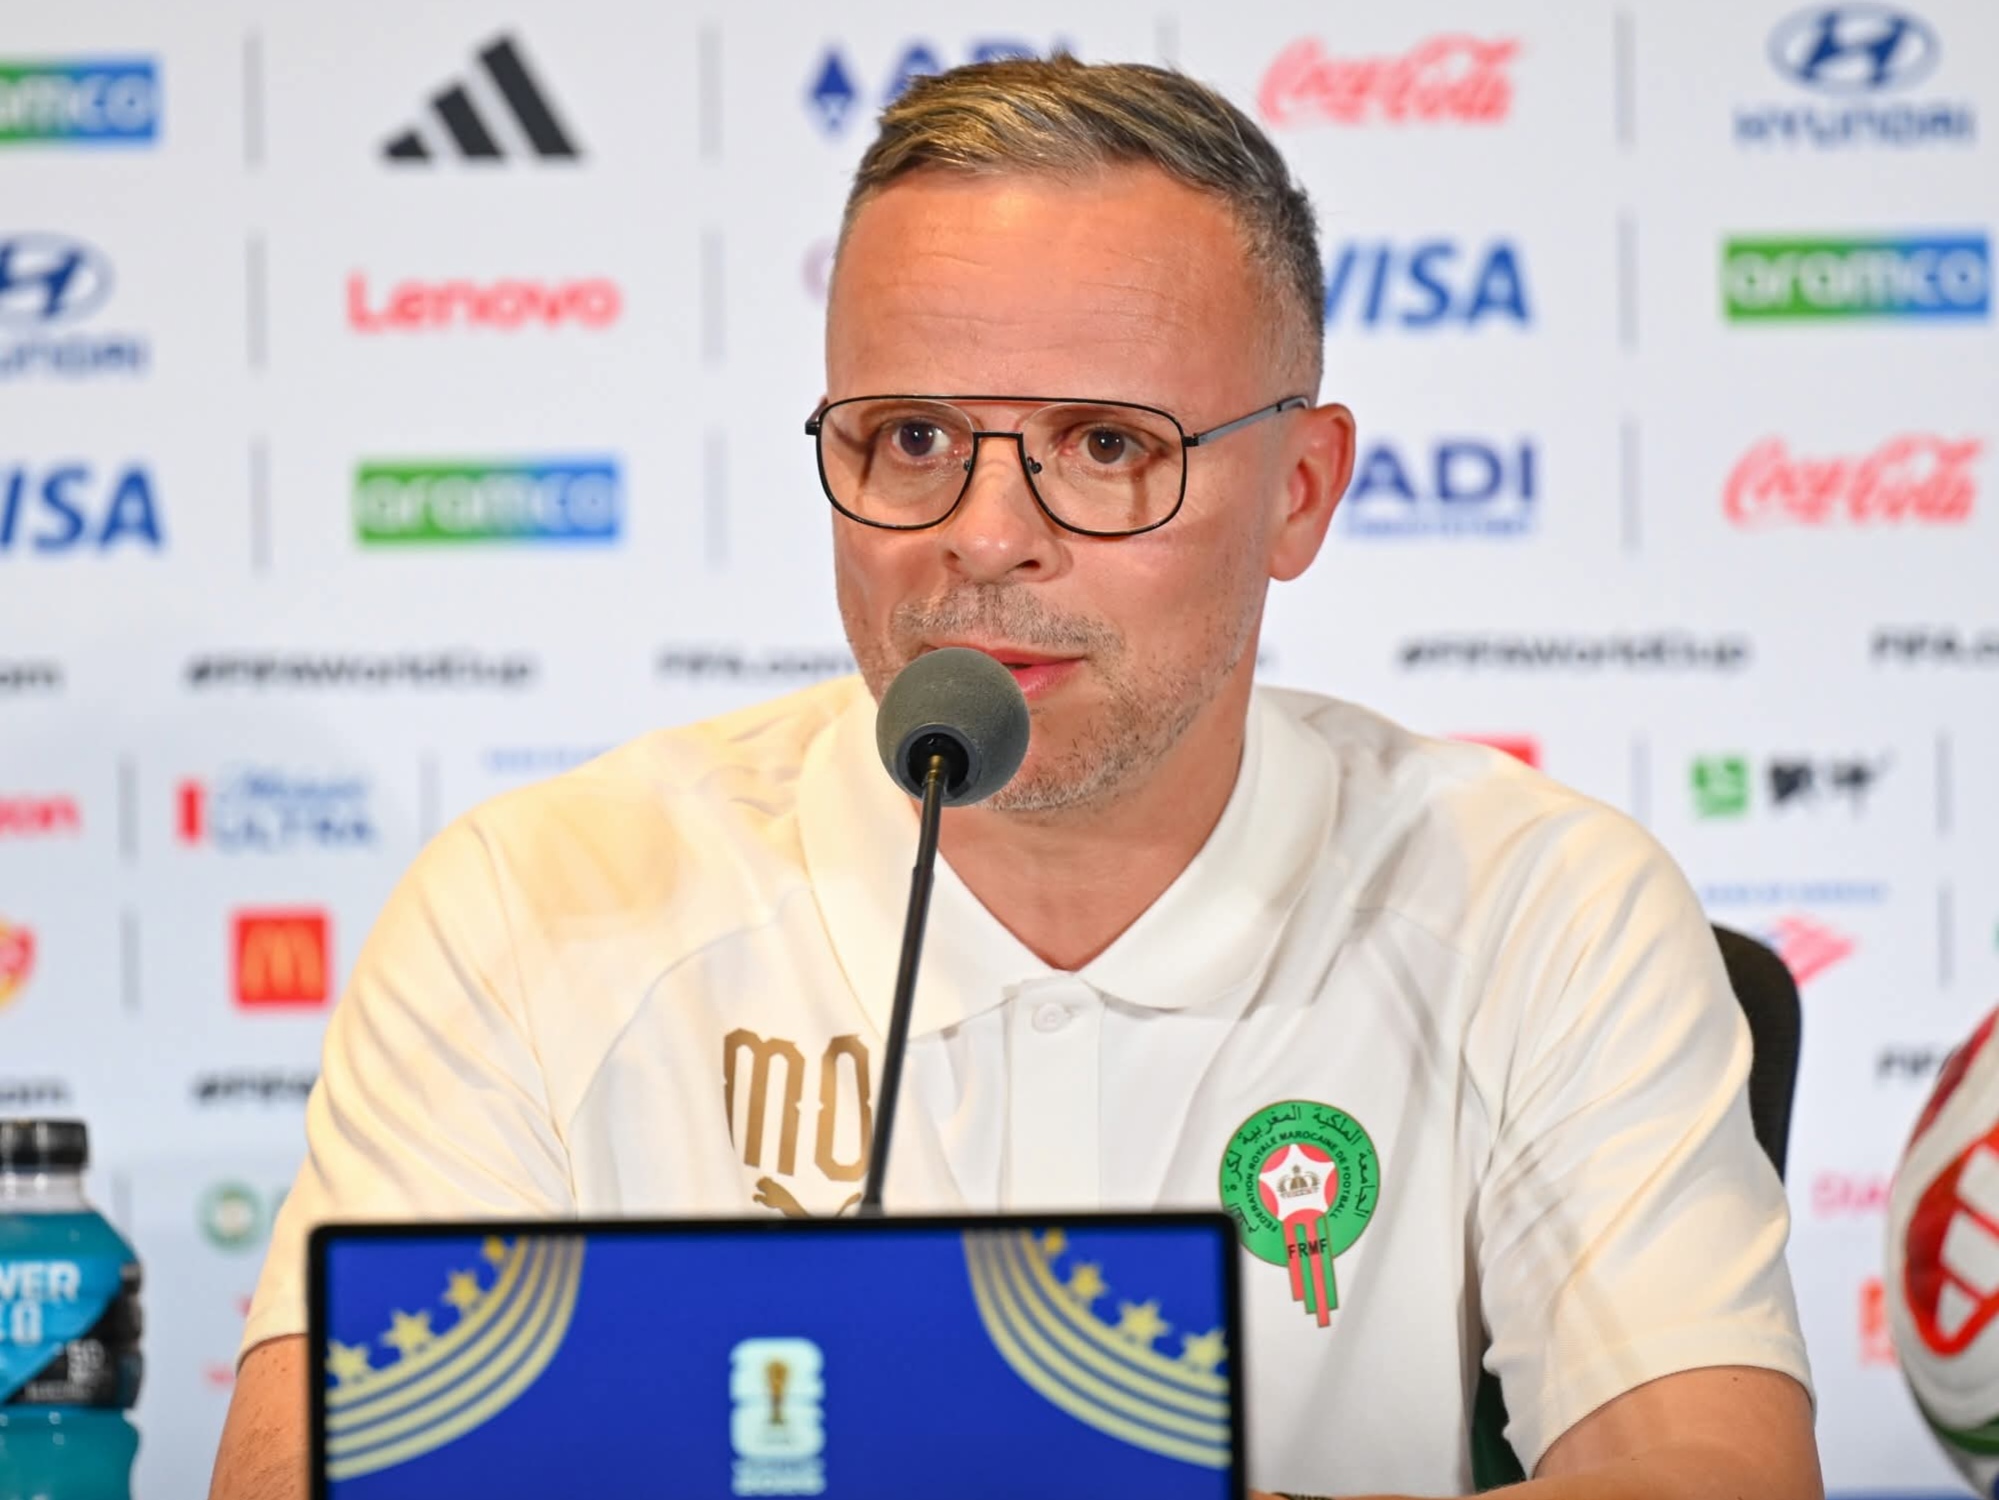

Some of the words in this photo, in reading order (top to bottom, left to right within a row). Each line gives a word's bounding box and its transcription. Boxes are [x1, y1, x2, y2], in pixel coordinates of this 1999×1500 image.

[1734, 105, 1976, 150] HYUNDAI
[1726, 246, 1986, 309] aramco
[346, 272, 622, 332] Lenovo
[1348, 440, 1538, 504] ADI
[1238, 1104, 1302, 1145] المغربية
[1279, 1130, 1339, 1154] MAROCAINE
[1312, 1106, 1362, 1146] الملكية
[1224, 1150, 1243, 1192] لكرة
[1248, 1136, 1279, 1170] ROYALE
[1335, 1149, 1348, 1164] DE
[1328, 1164, 1352, 1219] FOOTBALL
[1353, 1148, 1376, 1219] الجامعة
[1286, 1238, 1328, 1259] FRMF
